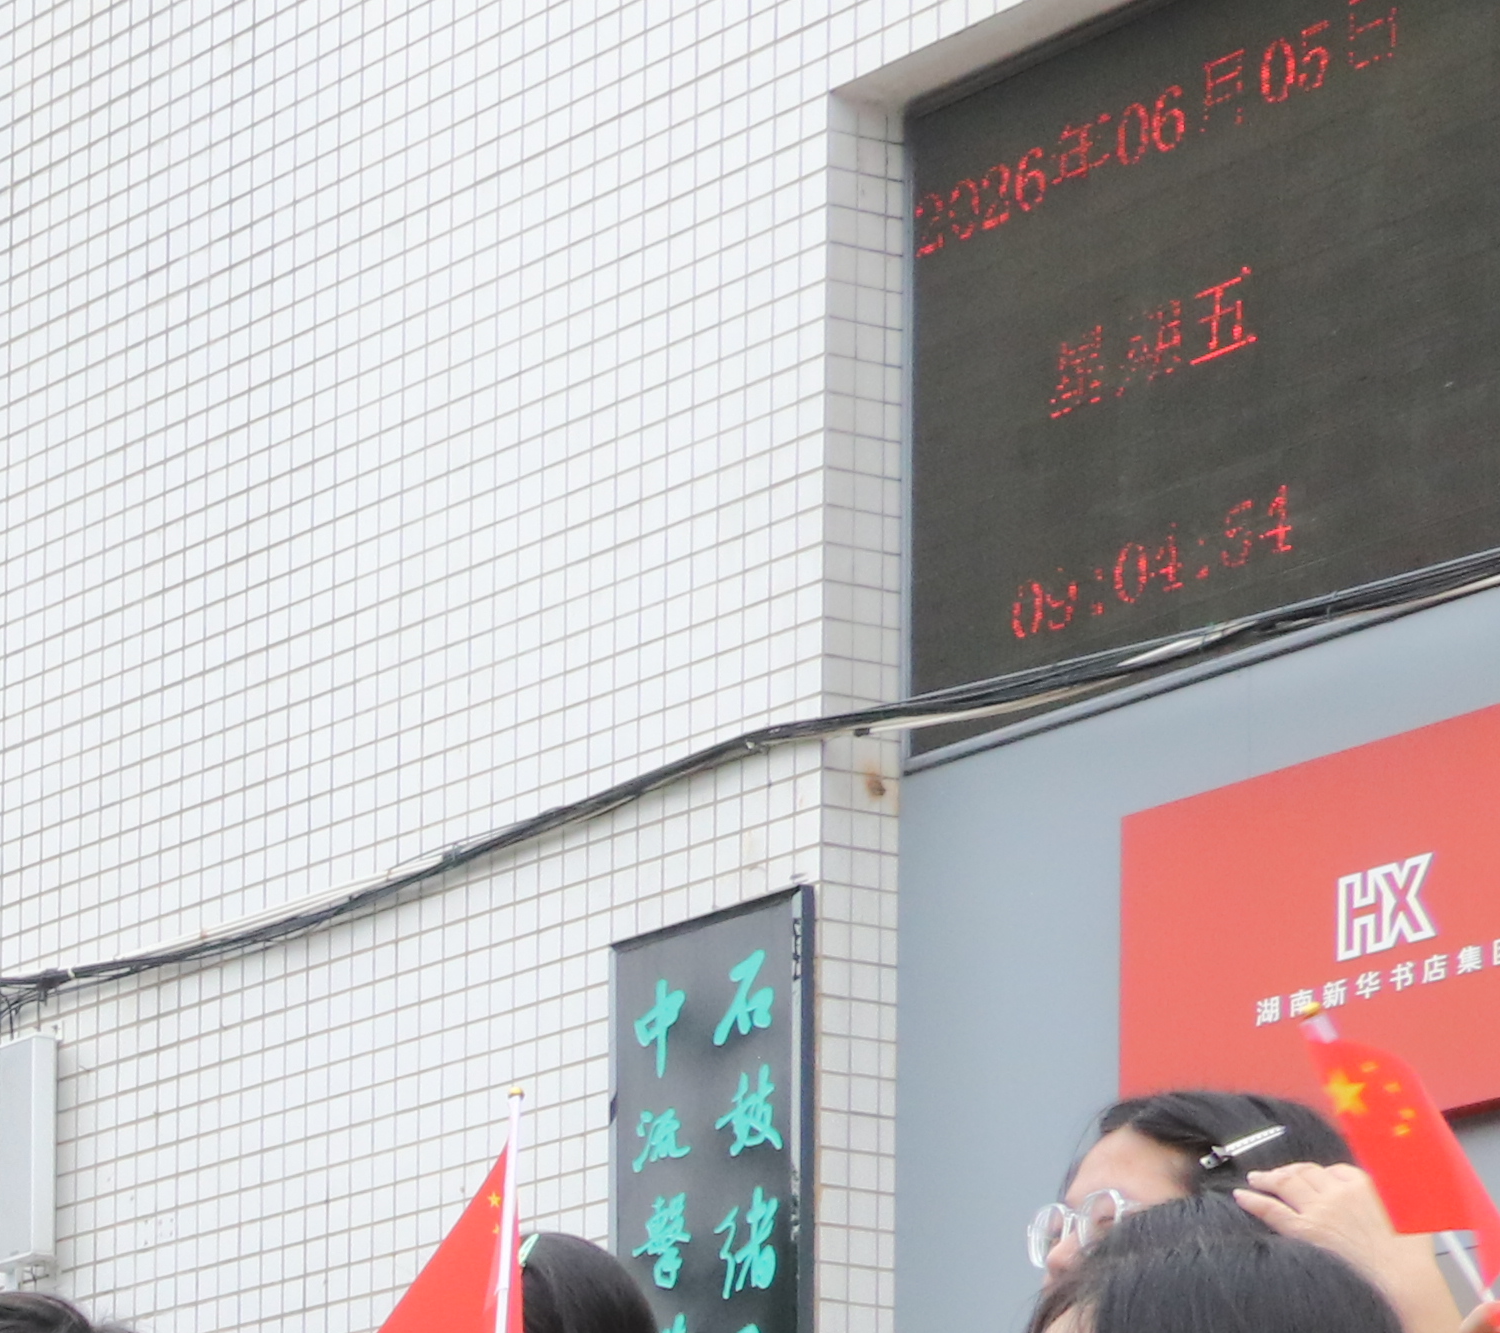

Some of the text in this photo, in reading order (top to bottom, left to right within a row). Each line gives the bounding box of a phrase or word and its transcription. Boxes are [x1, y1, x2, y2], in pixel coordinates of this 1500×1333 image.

[1011, 484, 1293, 638] 09:04:54
[1336, 851, 1438, 962] HX
[1255, 937, 1500, 1027] 湖南新华书店集
